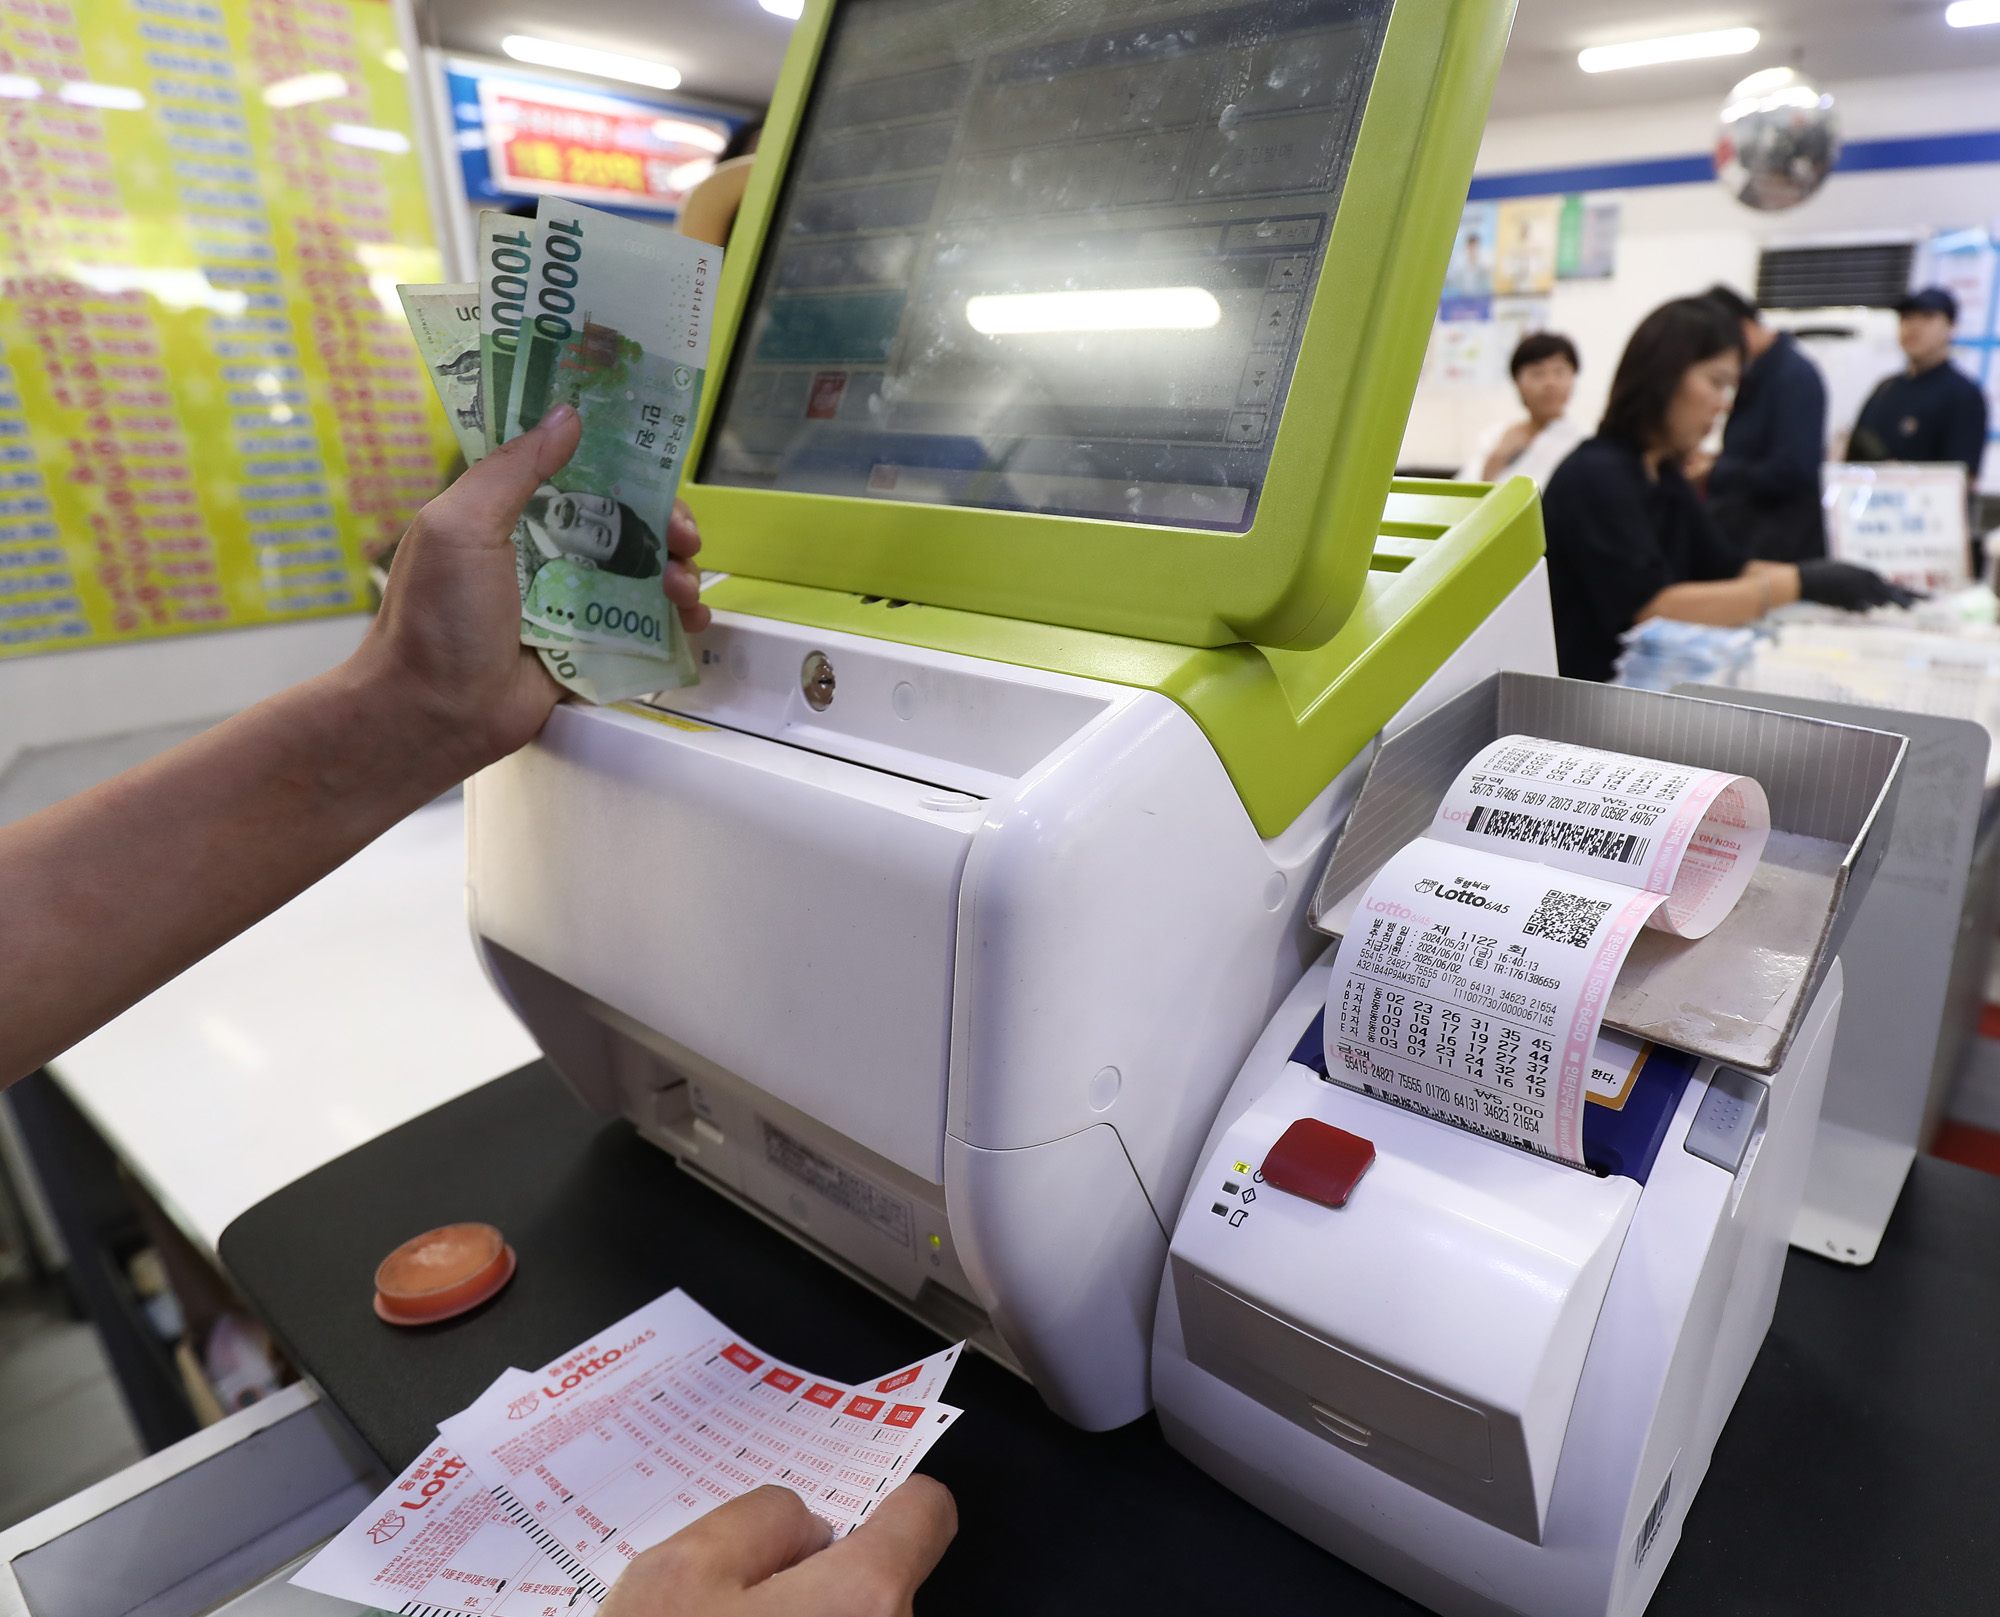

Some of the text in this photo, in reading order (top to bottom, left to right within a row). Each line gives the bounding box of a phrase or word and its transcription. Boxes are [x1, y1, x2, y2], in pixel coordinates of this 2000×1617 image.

[535, 220, 583, 340] 10000
[636, 405, 661, 449] 만원
[660, 415, 686, 469] 한국은행
[586, 602, 661, 642] 10000
[1471, 774, 1504, 786] 금액
[1626, 788, 1647, 796] 22
[1654, 793, 1676, 801] 23
[1470, 782, 1658, 827] 56775 97466 15819 72073 32178 03582 49767
[1715, 838, 1742, 851] TSCN
[1454, 877, 1490, 891] 동행복권
[1364, 938, 1461, 973] 지급기한 2025/06/02
[1421, 932, 1469, 951] 2024/05/31
[1474, 946, 1493, 958] (금)
[1500, 953, 1539, 971] 16:40:13
[1431, 923, 1527, 957] 제 1122 회
[1359, 949, 1557, 1014] 55415 24827 75555 01720 64131 34623 21654
[1416, 942, 1465, 962] 2024/06/01
[1469, 956, 1489, 970] (토)
[1493, 963, 1560, 989] TR:1761386659
[1453, 987, 1554, 1027] 111007730/0000067145
[1573, 934, 1624, 1042] 문의안내 1588-6450
[1344, 991, 1349, 999] B
[1386, 1005, 1402, 1016] 10
[1414, 1014, 1430, 1025] 15
[1442, 1022, 1459, 1034] 17
[1472, 1032, 1488, 1044] 19
[1498, 1040, 1519, 1052] 27
[1529, 1052, 1550, 1063] 44
[1347, 980, 1352, 989] A
[1387, 992, 1405, 1004] 02
[1413, 1001, 1433, 1013] 23
[1441, 1010, 1461, 1022] 26
[1471, 1019, 1489, 1032] 31
[1501, 1028, 1520, 1041] 35
[1532, 1039, 1552, 1051] 45
[1341, 1013, 1346, 1022] D
[1381, 1026, 1397, 1038] 01
[1408, 1035, 1426, 1047] 04
[1436, 1045, 1455, 1057] 23
[1465, 1054, 1484, 1066] 24
[1495, 1064, 1515, 1077] 32
[1526, 1074, 1546, 1086] 42
[1342, 1002, 1347, 1011] C
[1382, 1015, 1400, 1027] 03
[1410, 1024, 1427, 1036] 04
[1440, 1034, 1456, 1046] 16
[1469, 1044, 1487, 1055] 17
[1496, 1052, 1517, 1064] 27
[1527, 1062, 1548, 1074] 37
[1341, 1023, 1345, 1032] E
[1380, 1037, 1398, 1049] 03
[1407, 1046, 1425, 1057] 07
[1437, 1056, 1452, 1067] 11
[1467, 1066, 1483, 1078] 14
[1497, 1076, 1514, 1088] 16
[1528, 1086, 1545, 1098] 19
[1592, 1068, 1617, 1084] 한다.
[1344, 1054, 1539, 1134] 55415 24827 75555 01720 64131 34623 21654
[1560, 1067, 1580, 1119] 인터넷구매
[398, 1447, 449, 1491] 동행복권
[400, 1456, 466, 1510] Lott
[440, 1568, 456, 1579] 자동
[462, 1574, 485, 1586] 반자동
[482, 1577, 499, 1587] 선택
[517, 1582, 534, 1592] 자동
[538, 1585, 562, 1595] 반자동
[561, 1586, 576, 1596] 선택
[464, 1596, 480, 1607] 취소
